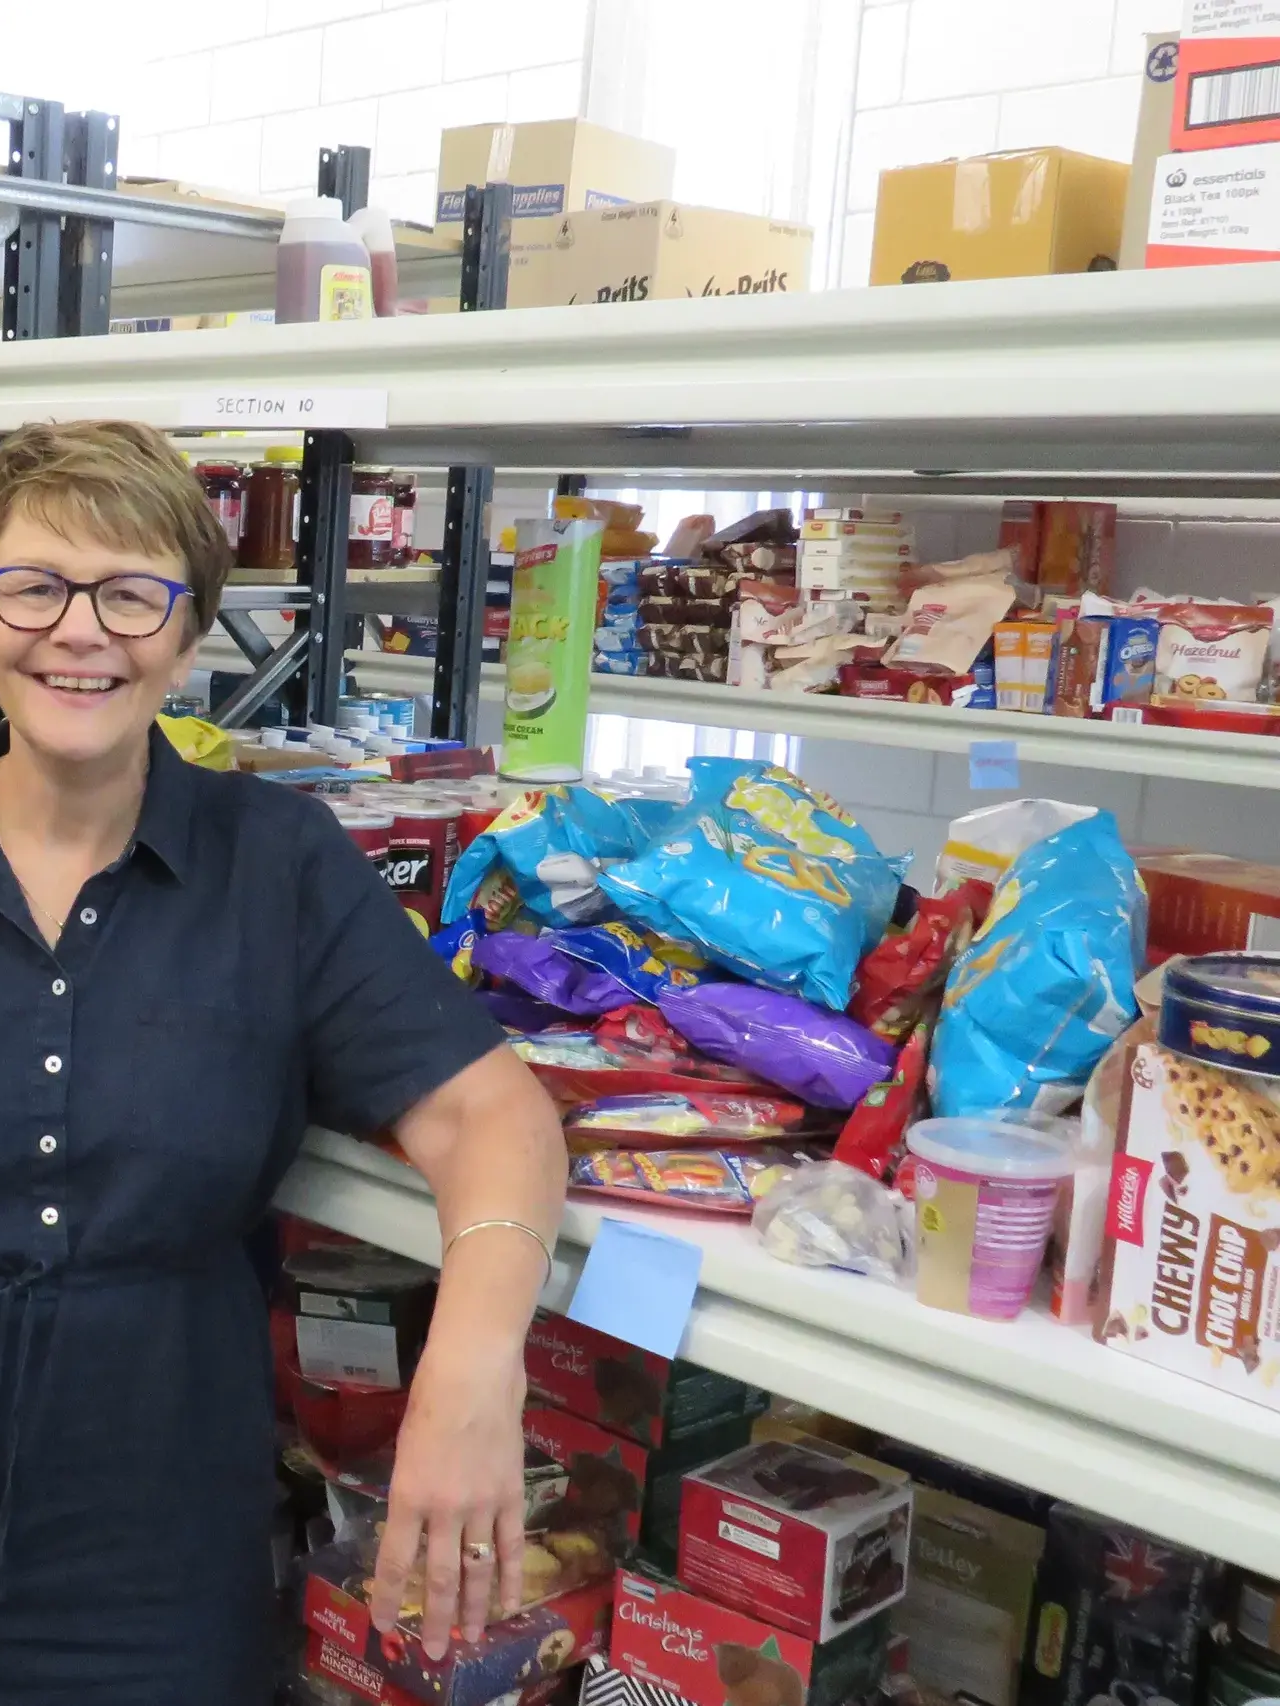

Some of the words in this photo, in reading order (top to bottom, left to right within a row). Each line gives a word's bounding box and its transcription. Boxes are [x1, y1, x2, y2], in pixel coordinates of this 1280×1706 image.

[1192, 168, 1266, 187] essentials
[513, 187, 560, 209] upplies
[1163, 193, 1195, 205] Black
[1201, 191, 1221, 201] Tea
[1225, 187, 1260, 199] 100pk
[216, 396, 284, 415] SECTION
[298, 396, 314, 413] 10
[1171, 644, 1242, 659] Hazelnut
[516, 726, 544, 735] CREAM
[386, 860, 428, 886] ker
[1118, 1166, 1140, 1233] Hillcrest
[1212, 1224, 1247, 1285] CHIP
[1151, 1201, 1201, 1335] CHEWY
[1205, 1284, 1239, 1349] CHOC
[526, 1328, 584, 1357] hristmas
[551, 1352, 589, 1377] Cake
[619, 1602, 703, 1641] Christmas
[662, 1635, 708, 1662] Cake
[320, 1652, 382, 1692] MINCEMEAT
